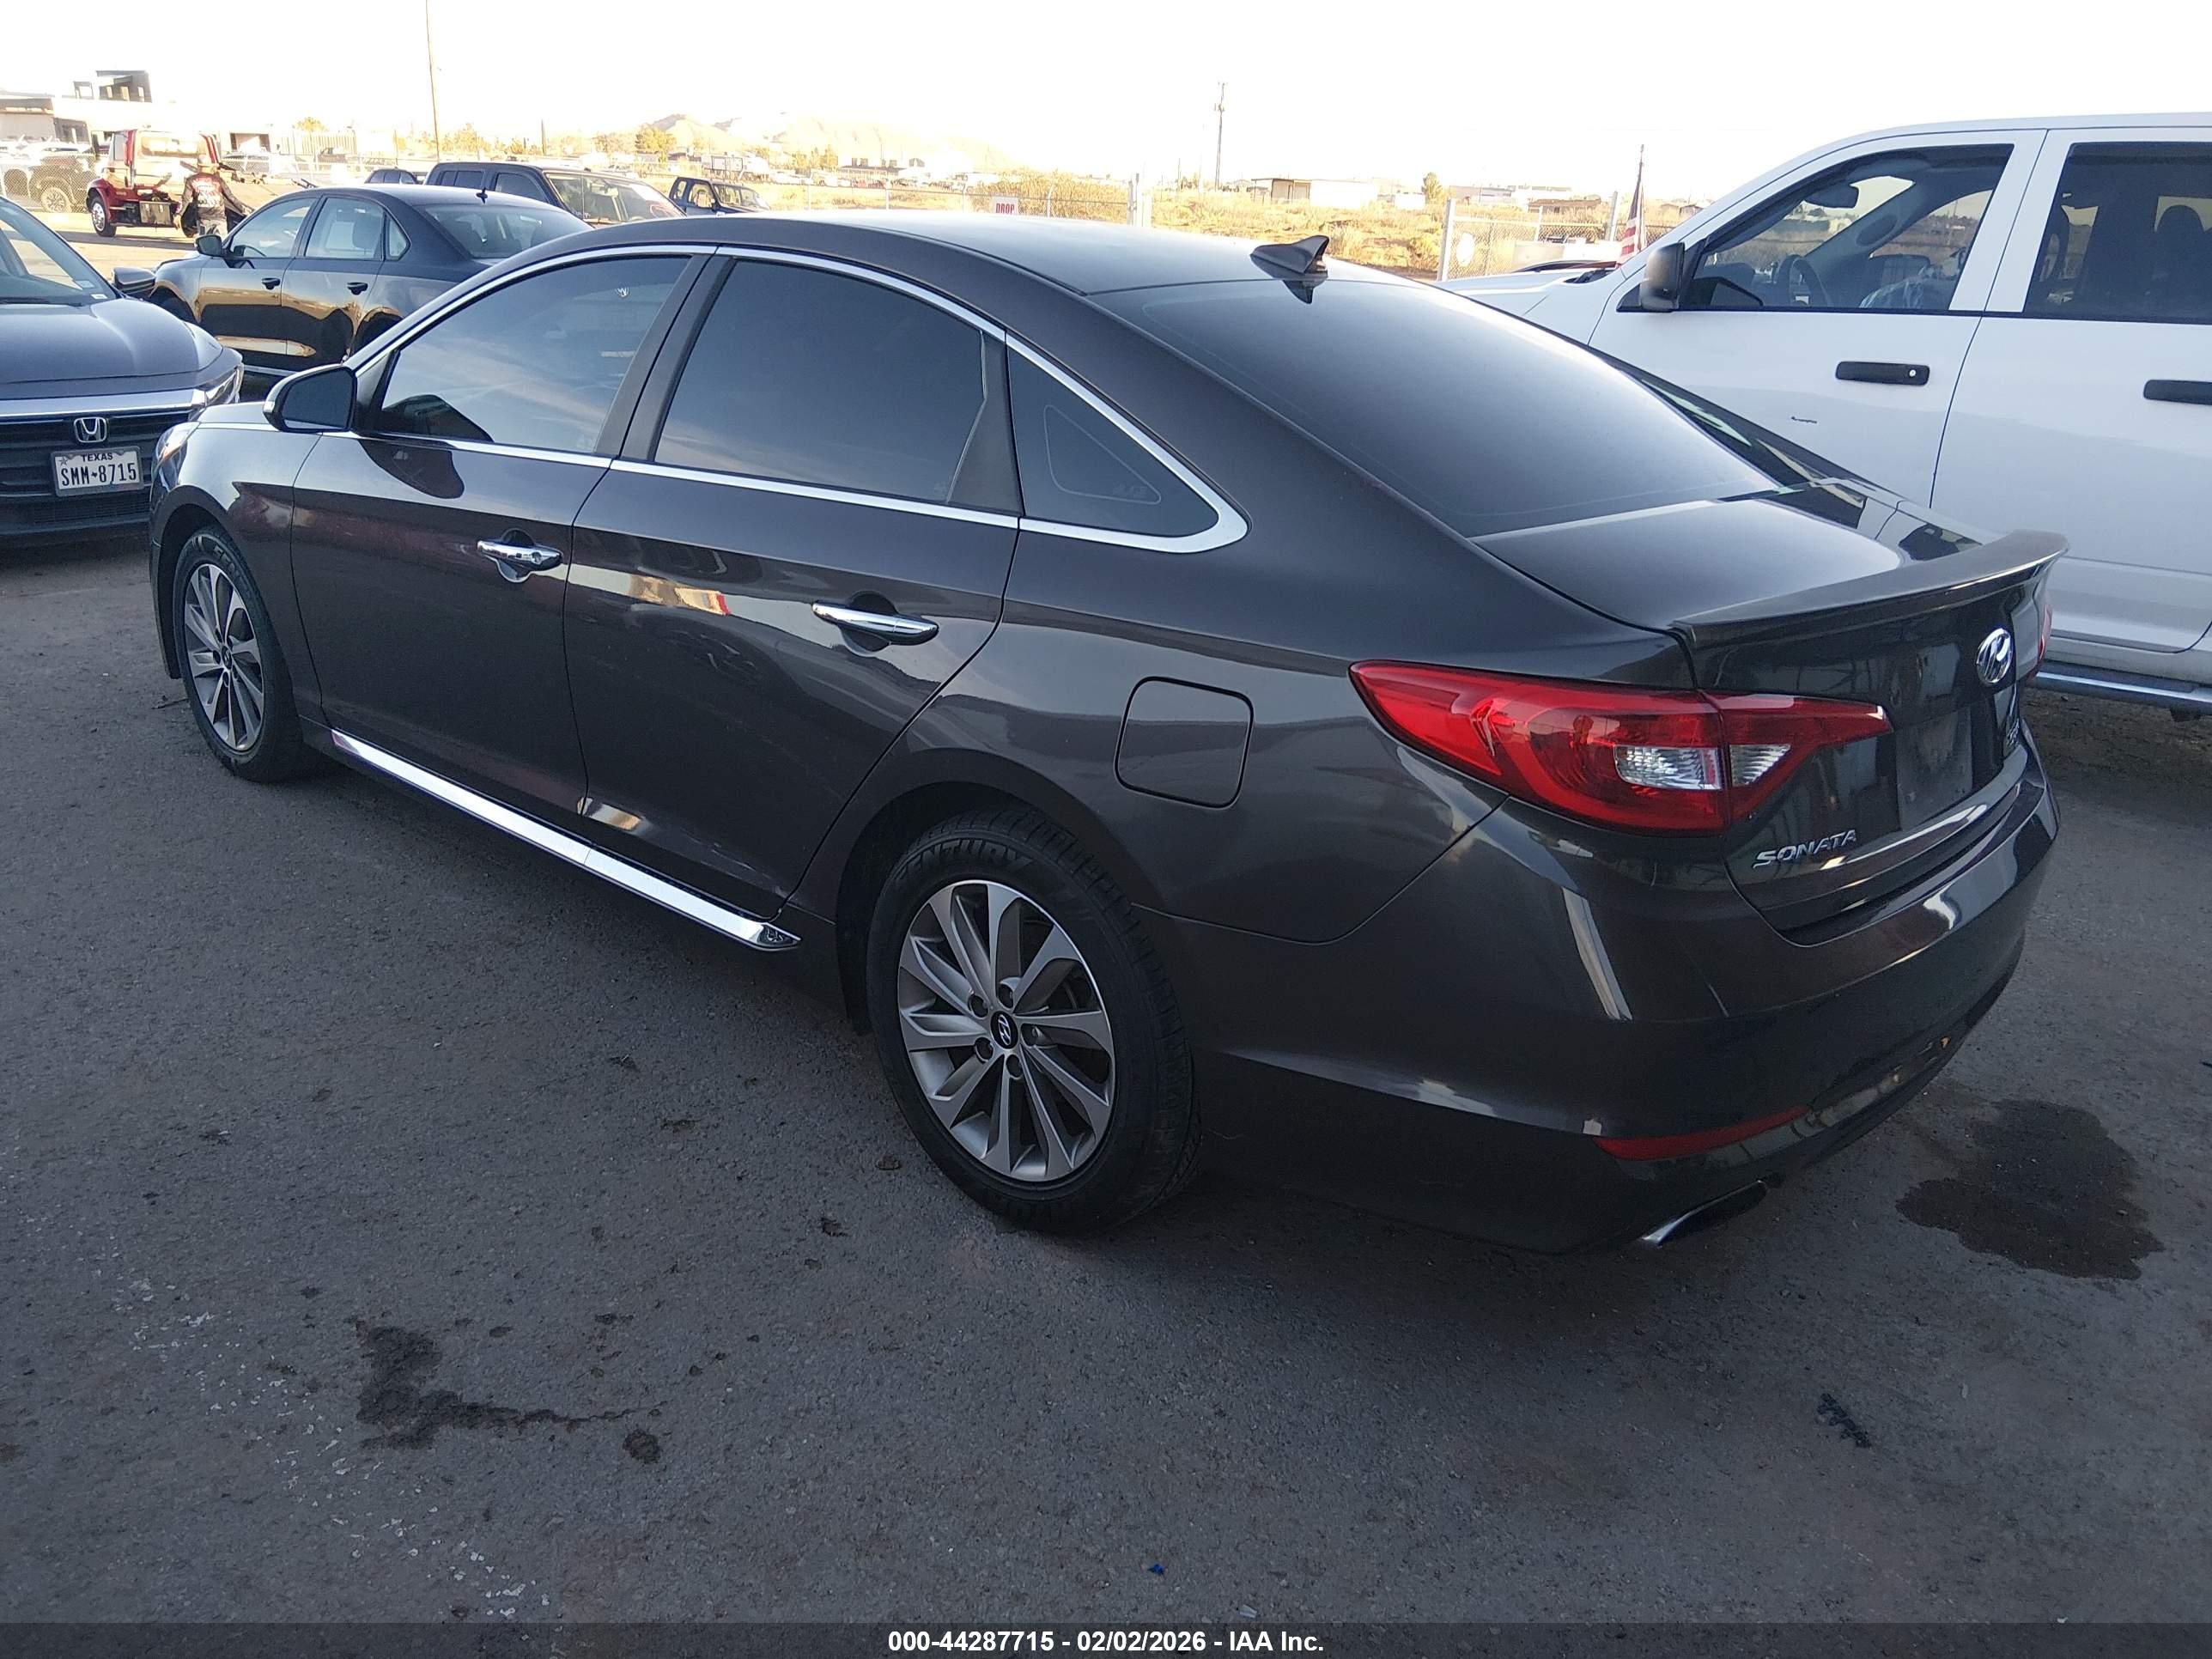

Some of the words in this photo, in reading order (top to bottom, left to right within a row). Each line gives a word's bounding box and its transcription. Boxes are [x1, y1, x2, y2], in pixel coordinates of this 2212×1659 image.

[996, 203, 1015, 215] DROP
[81, 453, 113, 463] TEXAS
[1753, 830, 1856, 869] SONATA
